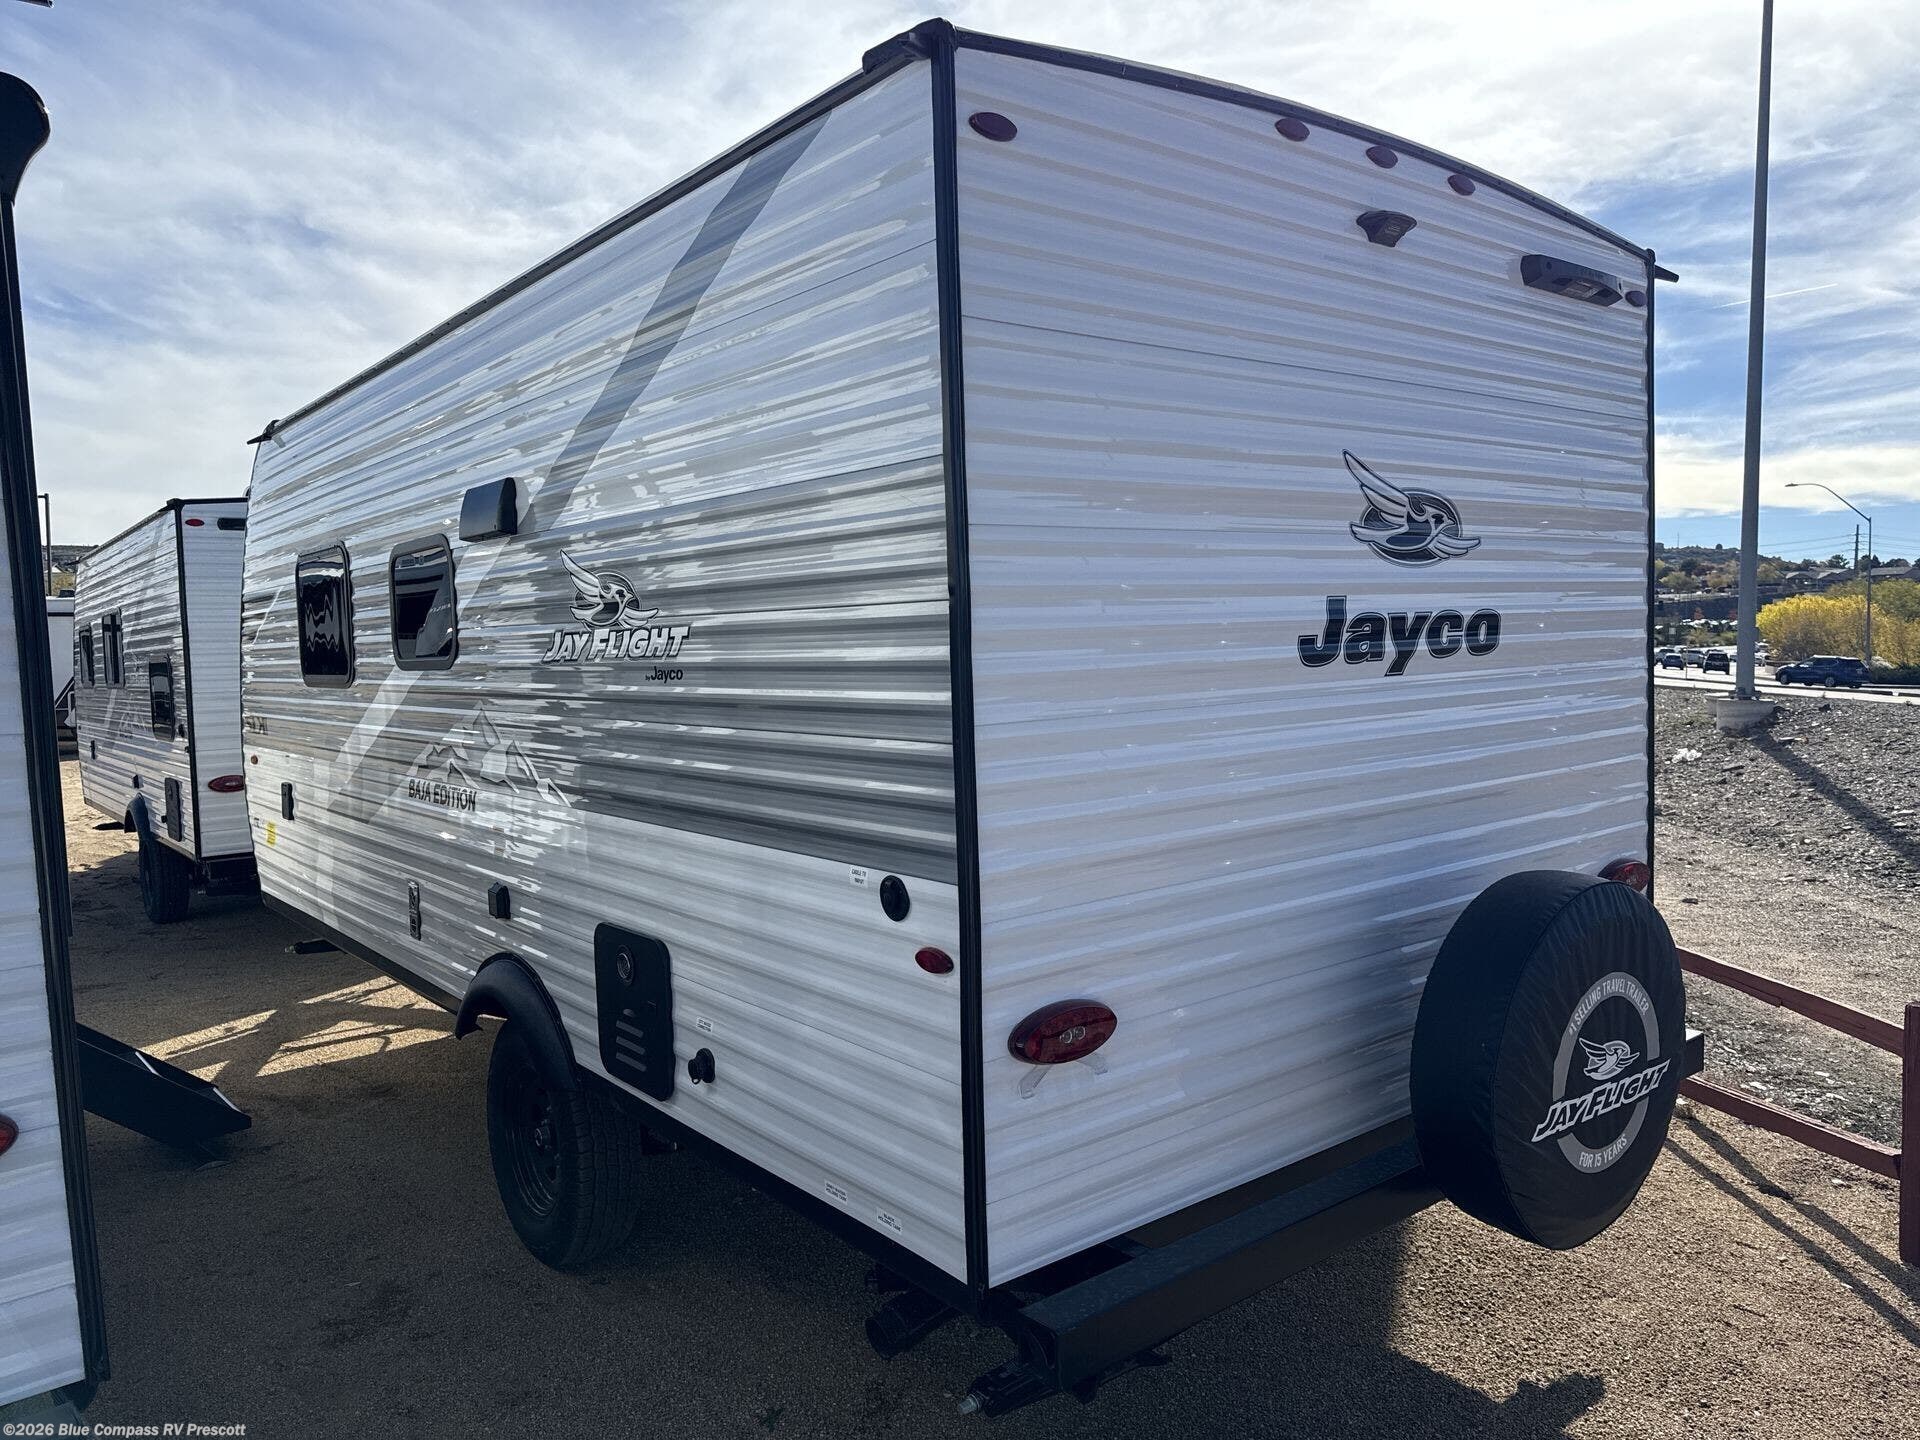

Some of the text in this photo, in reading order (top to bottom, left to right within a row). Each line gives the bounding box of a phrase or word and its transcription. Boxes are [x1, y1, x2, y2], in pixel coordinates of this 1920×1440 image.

[541, 625, 691, 663] JAY FLIGHT
[1297, 595, 1502, 677] Jayco
[651, 666, 683, 683] Jayco
[408, 779, 477, 812] BAJA EDITION
[1574, 986, 1602, 1025] SELLING
[1602, 978, 1625, 996] TRAVEL
[1625, 981, 1649, 1016] TRAILER
[1531, 1058, 1672, 1143] JAY FLIGHT
[1579, 1133, 1628, 1168] FOR 15 YEARS
